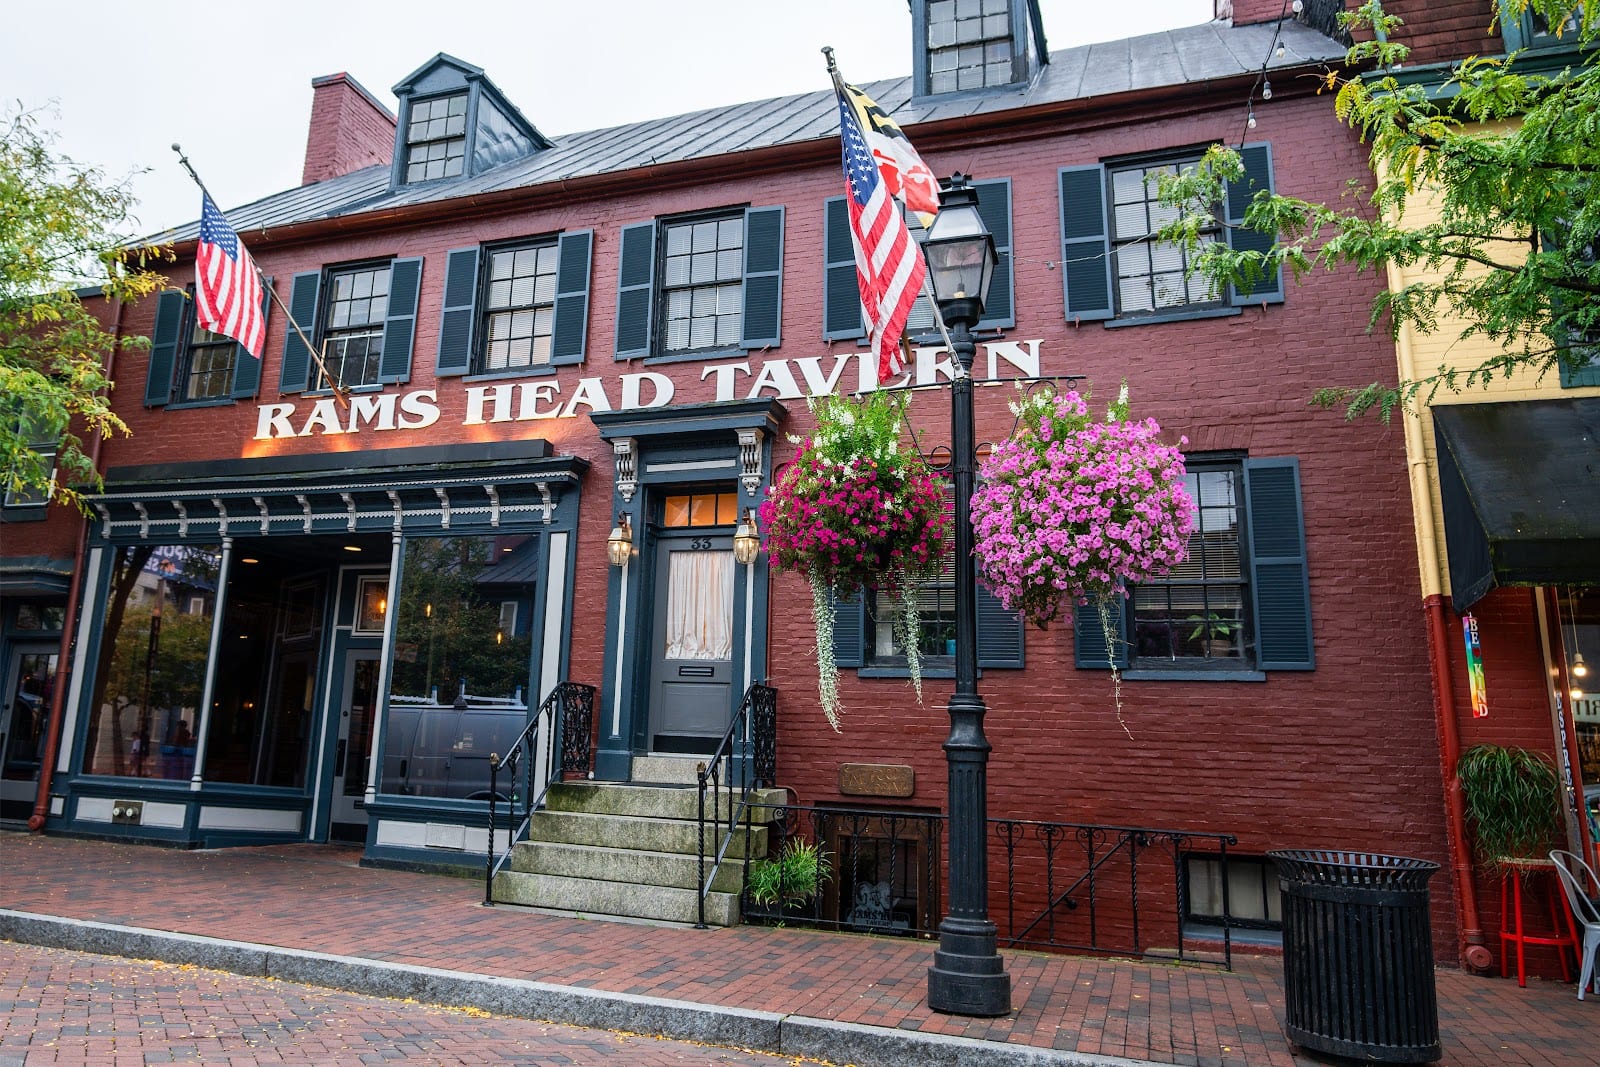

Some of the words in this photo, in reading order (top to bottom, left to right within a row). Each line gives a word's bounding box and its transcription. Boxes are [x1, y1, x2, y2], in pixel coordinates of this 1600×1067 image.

[253, 390, 441, 440] RAMS
[462, 372, 675, 425] HEAD
[691, 537, 712, 550] 33
[1469, 618, 1480, 645] BE
[1474, 663, 1489, 717] KIND
